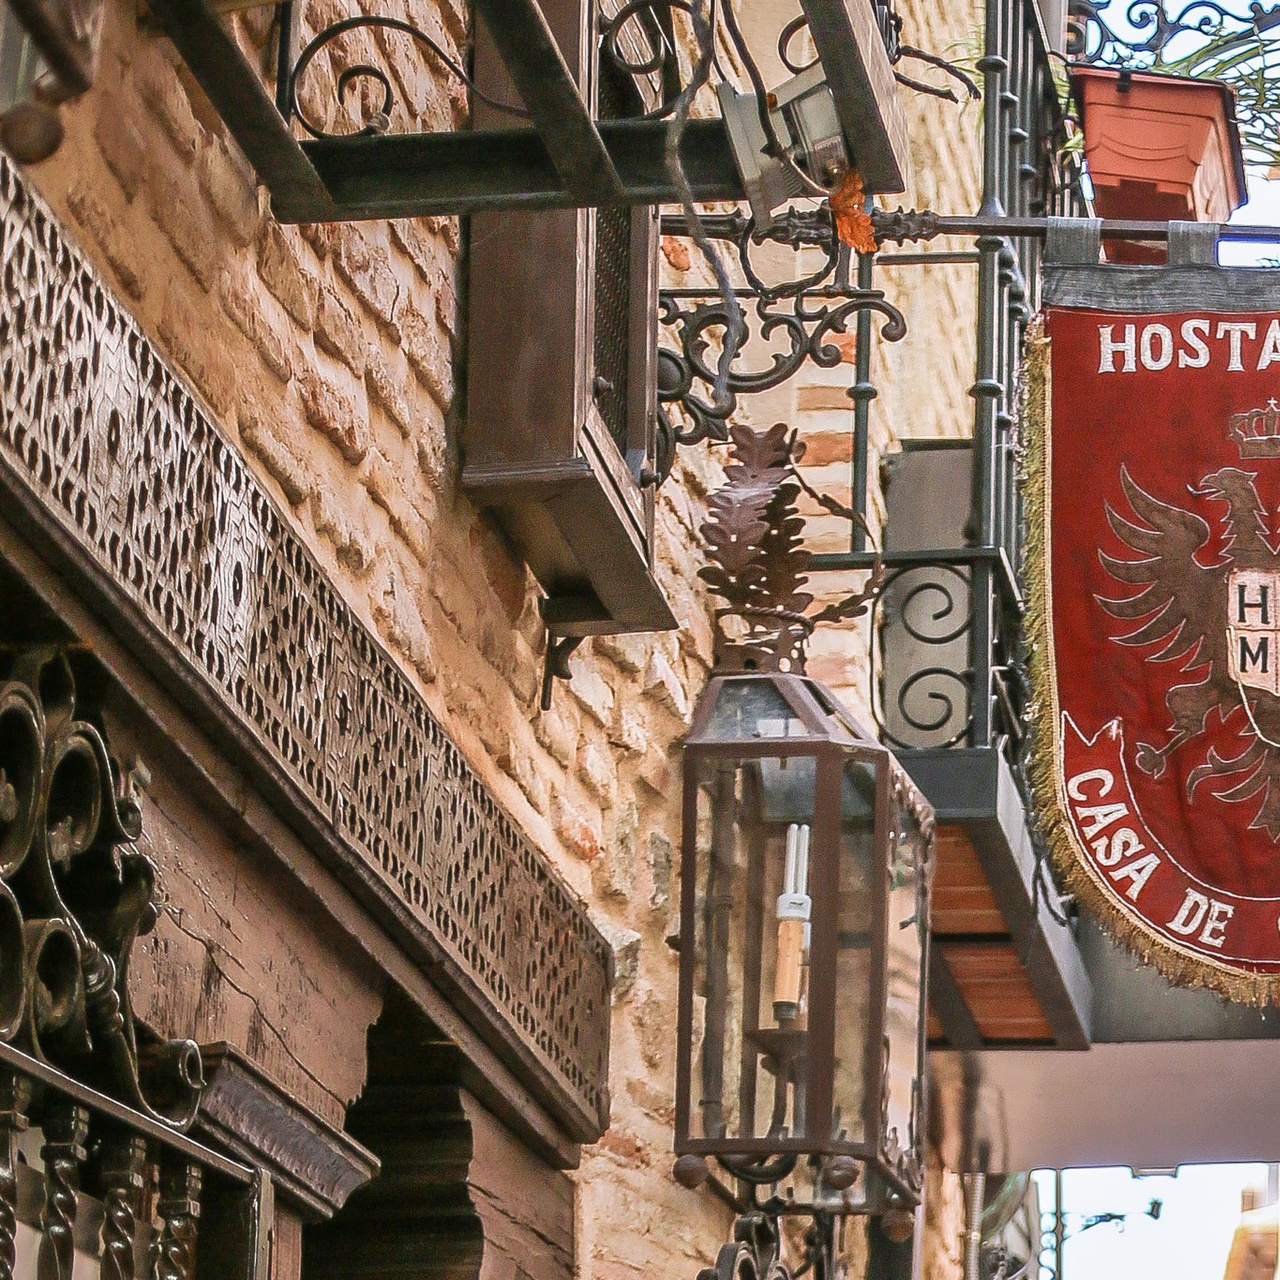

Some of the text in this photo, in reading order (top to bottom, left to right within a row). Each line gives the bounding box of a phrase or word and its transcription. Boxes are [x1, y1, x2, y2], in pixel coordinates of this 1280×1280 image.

[1237, 584, 1270, 625] H
[1239, 635, 1269, 674] M
[1067, 768, 1162, 901] CASA
[1166, 887, 1235, 948] DE
